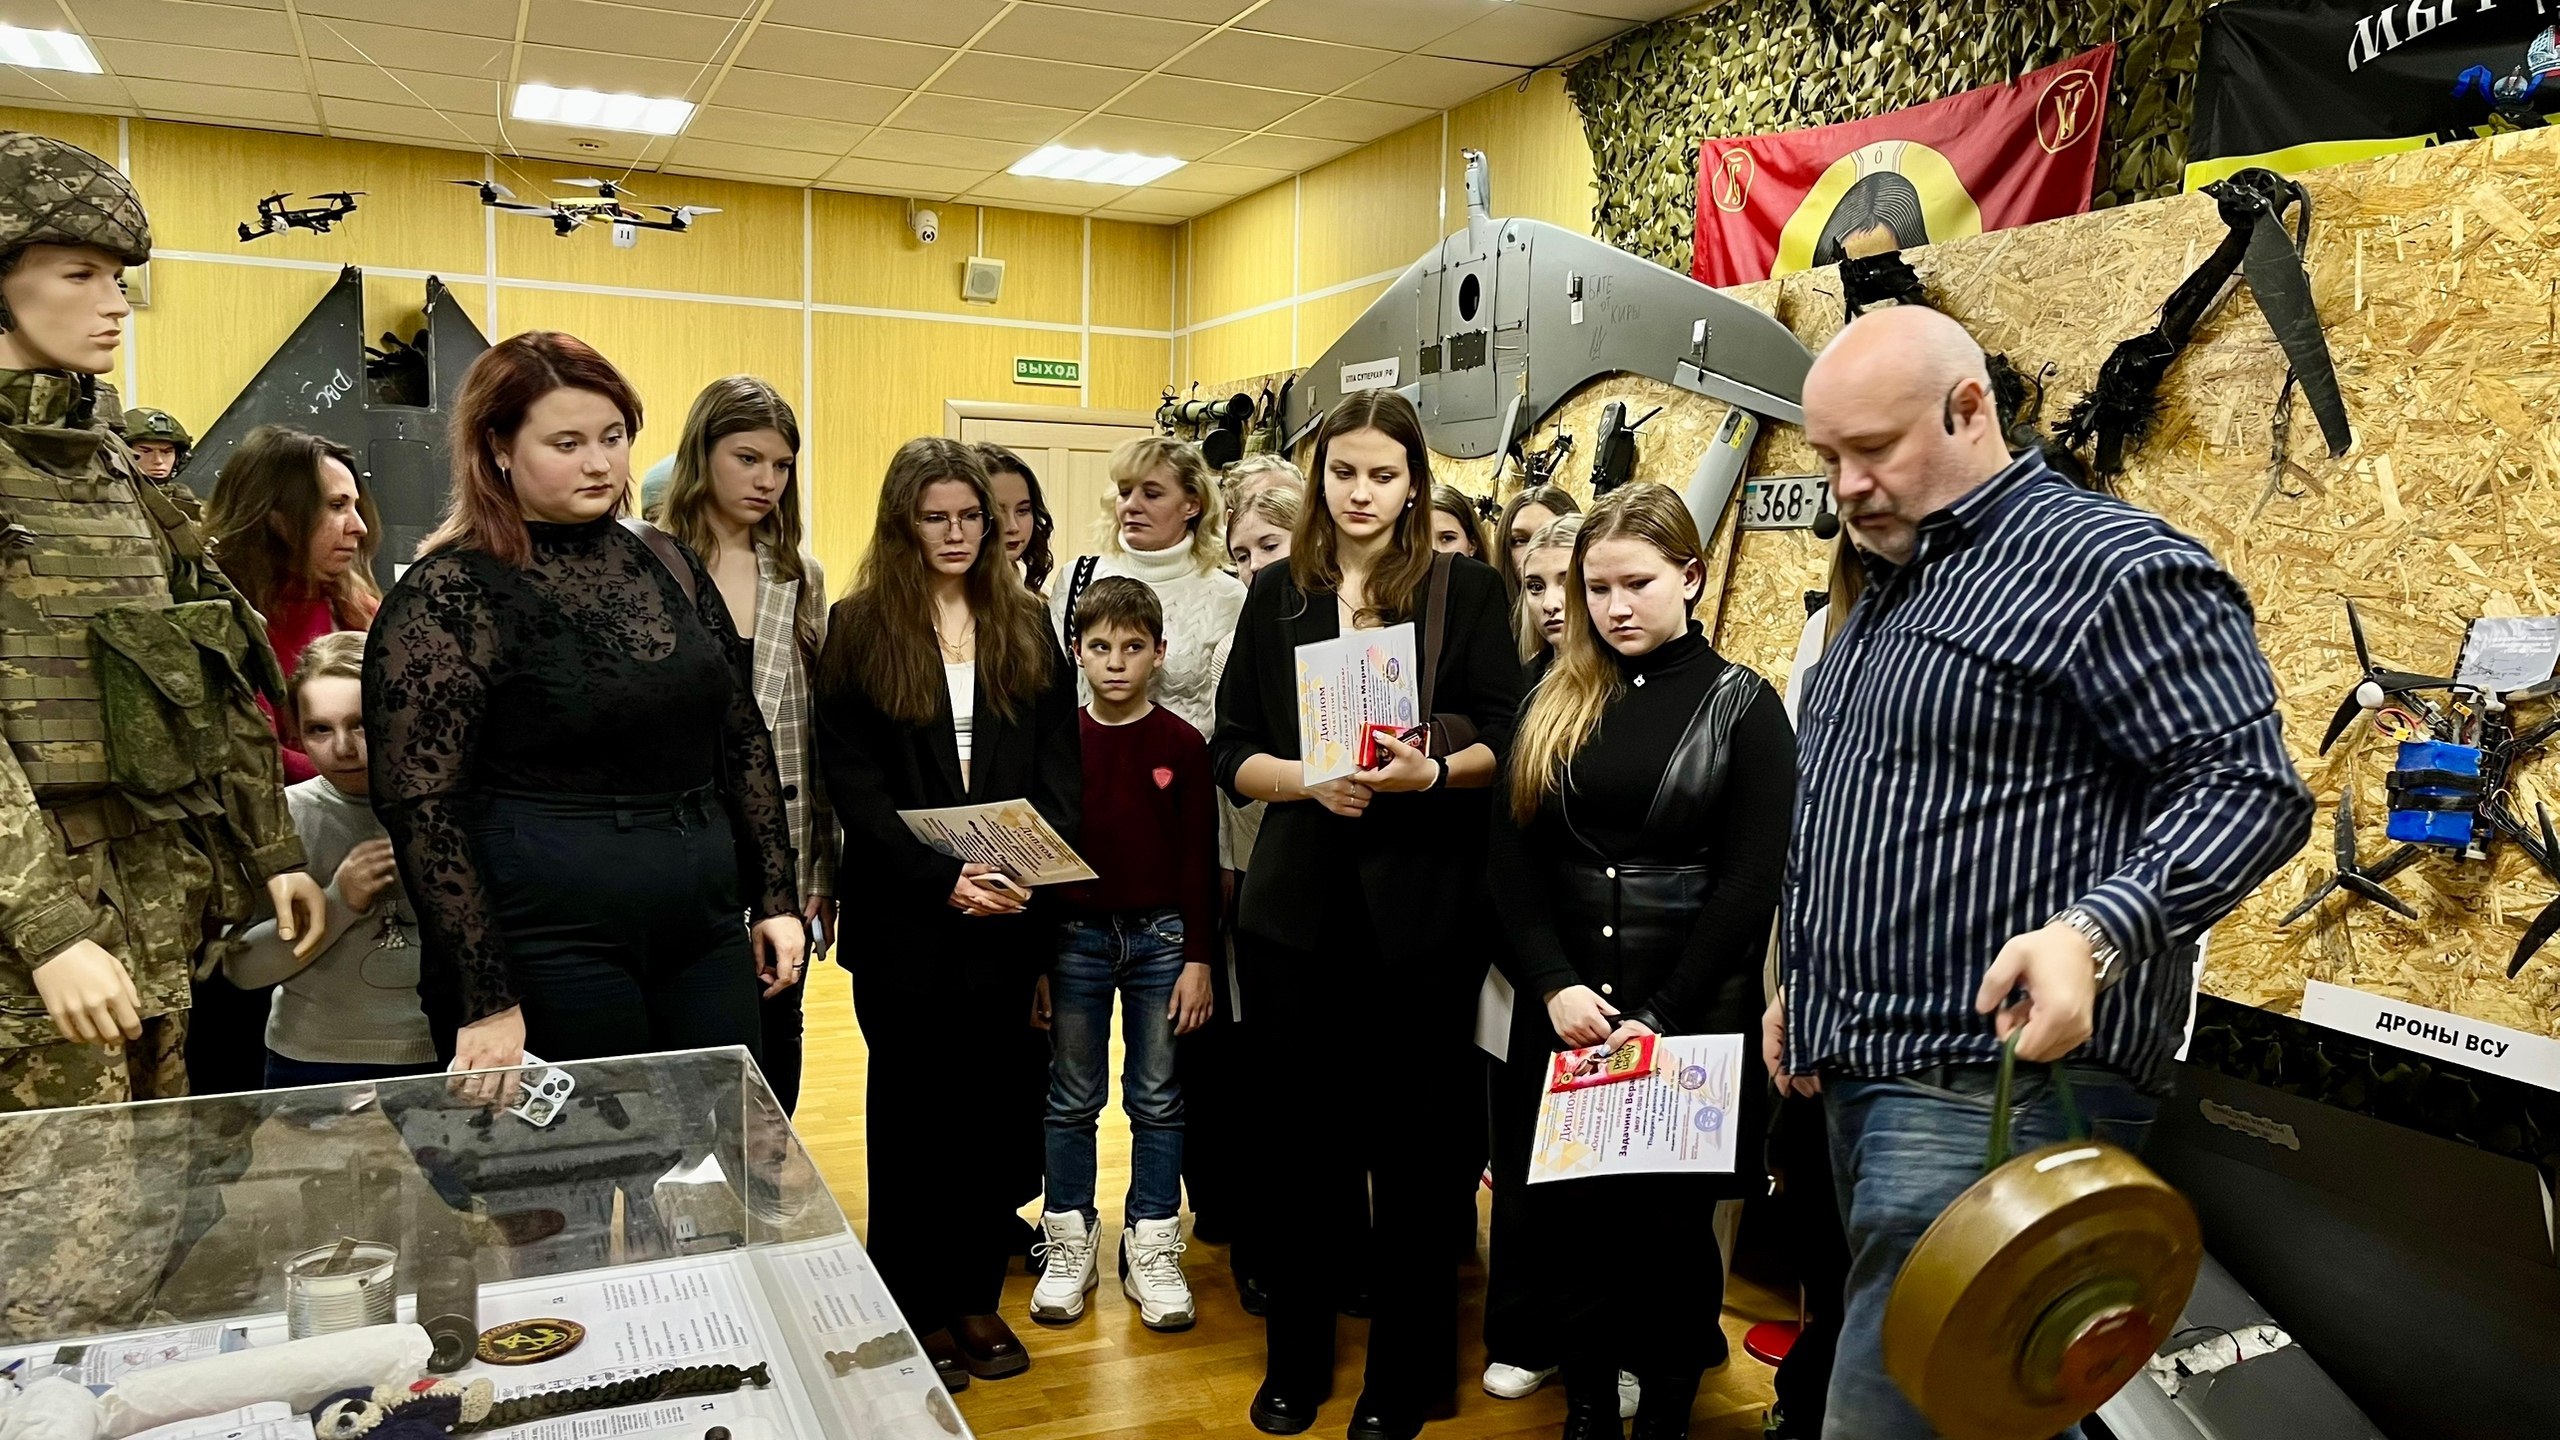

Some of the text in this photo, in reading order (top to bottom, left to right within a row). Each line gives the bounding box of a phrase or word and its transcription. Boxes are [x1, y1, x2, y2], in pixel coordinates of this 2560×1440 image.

[1018, 362, 1077, 379] ВЫХОД
[2375, 1011, 2510, 1058] ДРОНЫ ВСУ
[1619, 1079, 1636, 1157] Задачина Вера
